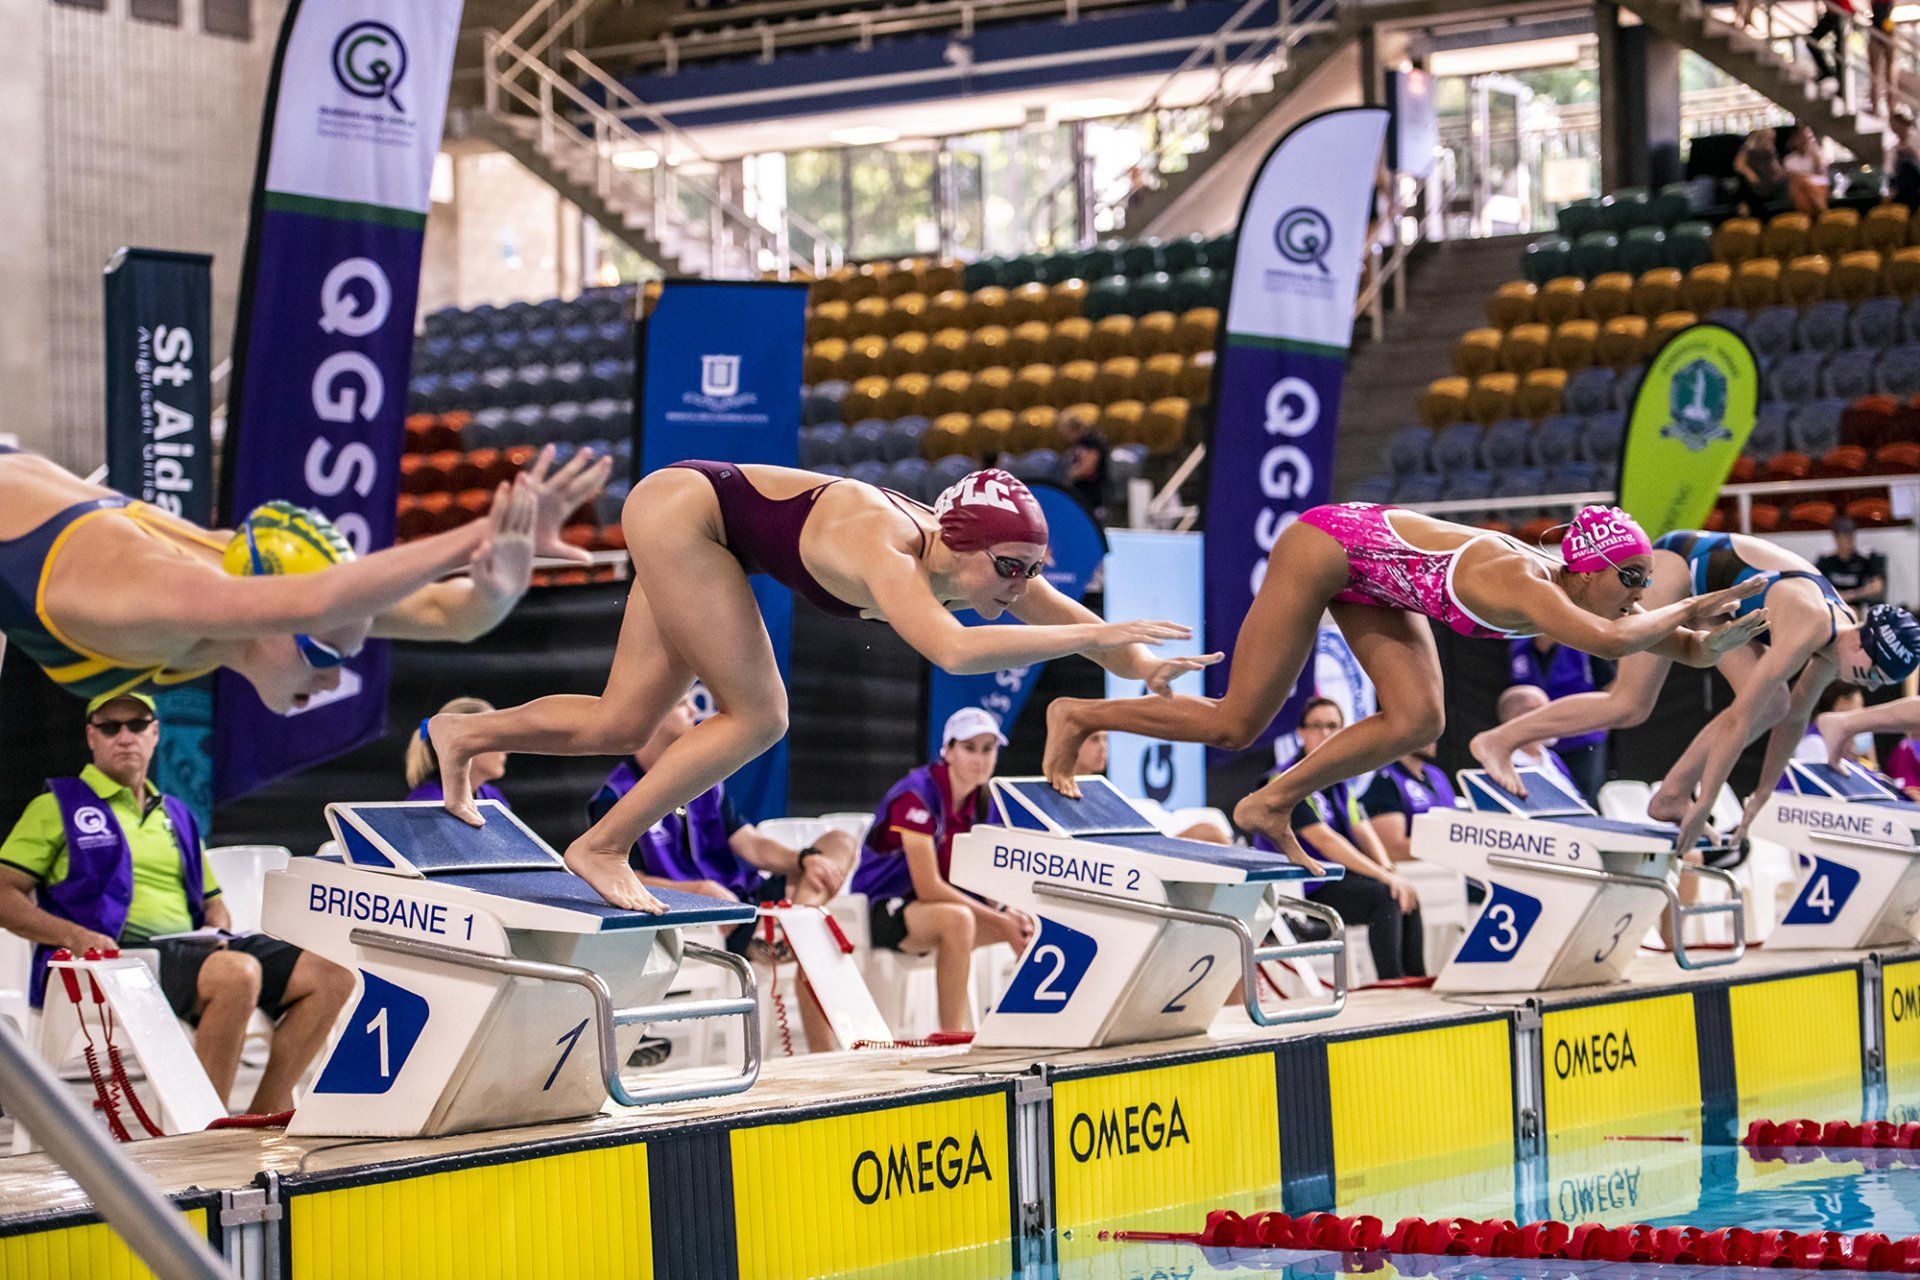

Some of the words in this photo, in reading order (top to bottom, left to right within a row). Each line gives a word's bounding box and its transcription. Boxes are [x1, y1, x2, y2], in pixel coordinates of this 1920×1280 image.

[135, 326, 154, 434] Anglican
[153, 324, 194, 387] St
[142, 443, 156, 501] Girls
[1250, 376, 1321, 598] QGS
[1571, 520, 1626, 552] mbc
[1450, 823, 1557, 856] BRISBANE
[1568, 842, 1581, 861] 3
[1777, 805, 1874, 834] BRISBANE
[1882, 821, 1893, 836] 4
[993, 845, 1115, 887] BRISBANE
[1126, 869, 1141, 891] 2
[1806, 874, 1835, 917] 4
[309, 883, 448, 935] BRISBANE
[463, 913, 474, 941] 1
[1488, 903, 1519, 953] 3
[1594, 912, 1633, 964] 3
[1033, 944, 1067, 1001] 2
[1161, 954, 1215, 1014] 2
[1891, 986, 1920, 1022] OM
[366, 1007, 390, 1078] 1
[542, 1017, 591, 1092] 1
[1554, 1028, 1637, 1080] OMEGA
[1070, 1096, 1191, 1163] OMEGA
[852, 1129, 993, 1205] OMEGA
